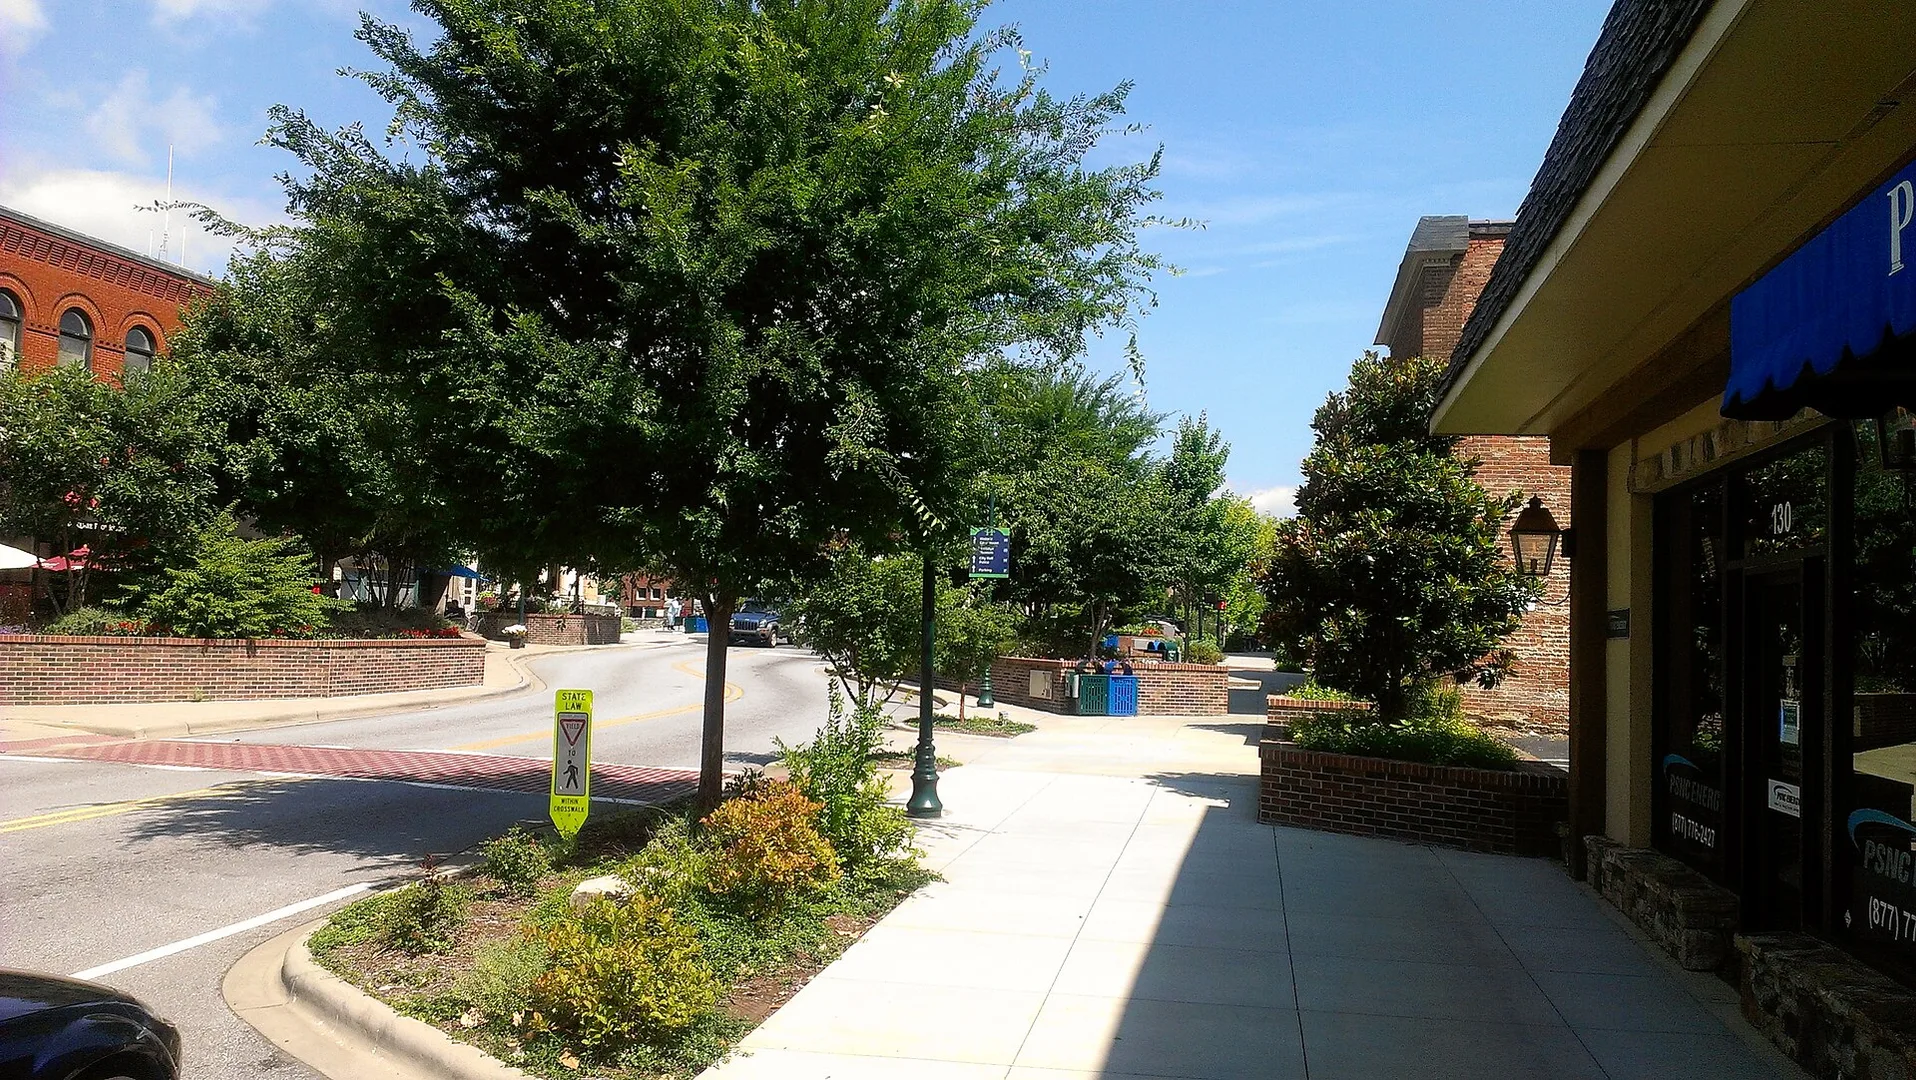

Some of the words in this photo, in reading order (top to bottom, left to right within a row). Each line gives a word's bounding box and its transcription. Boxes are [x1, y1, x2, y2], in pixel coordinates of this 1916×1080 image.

[1886, 179, 1914, 277] P
[1771, 501, 1791, 534] 130
[562, 692, 586, 701] STATE
[565, 702, 583, 710] LAW
[568, 749, 576, 757] TO
[1669, 773, 1691, 801] PSNC
[1691, 781, 1722, 812] ENERG
[553, 805, 585, 813] CROSSWALK
[1671, 811, 1687, 840] (877)
[1863, 839, 1911, 883] PSNC
[1868, 895, 1900, 941] (877)
